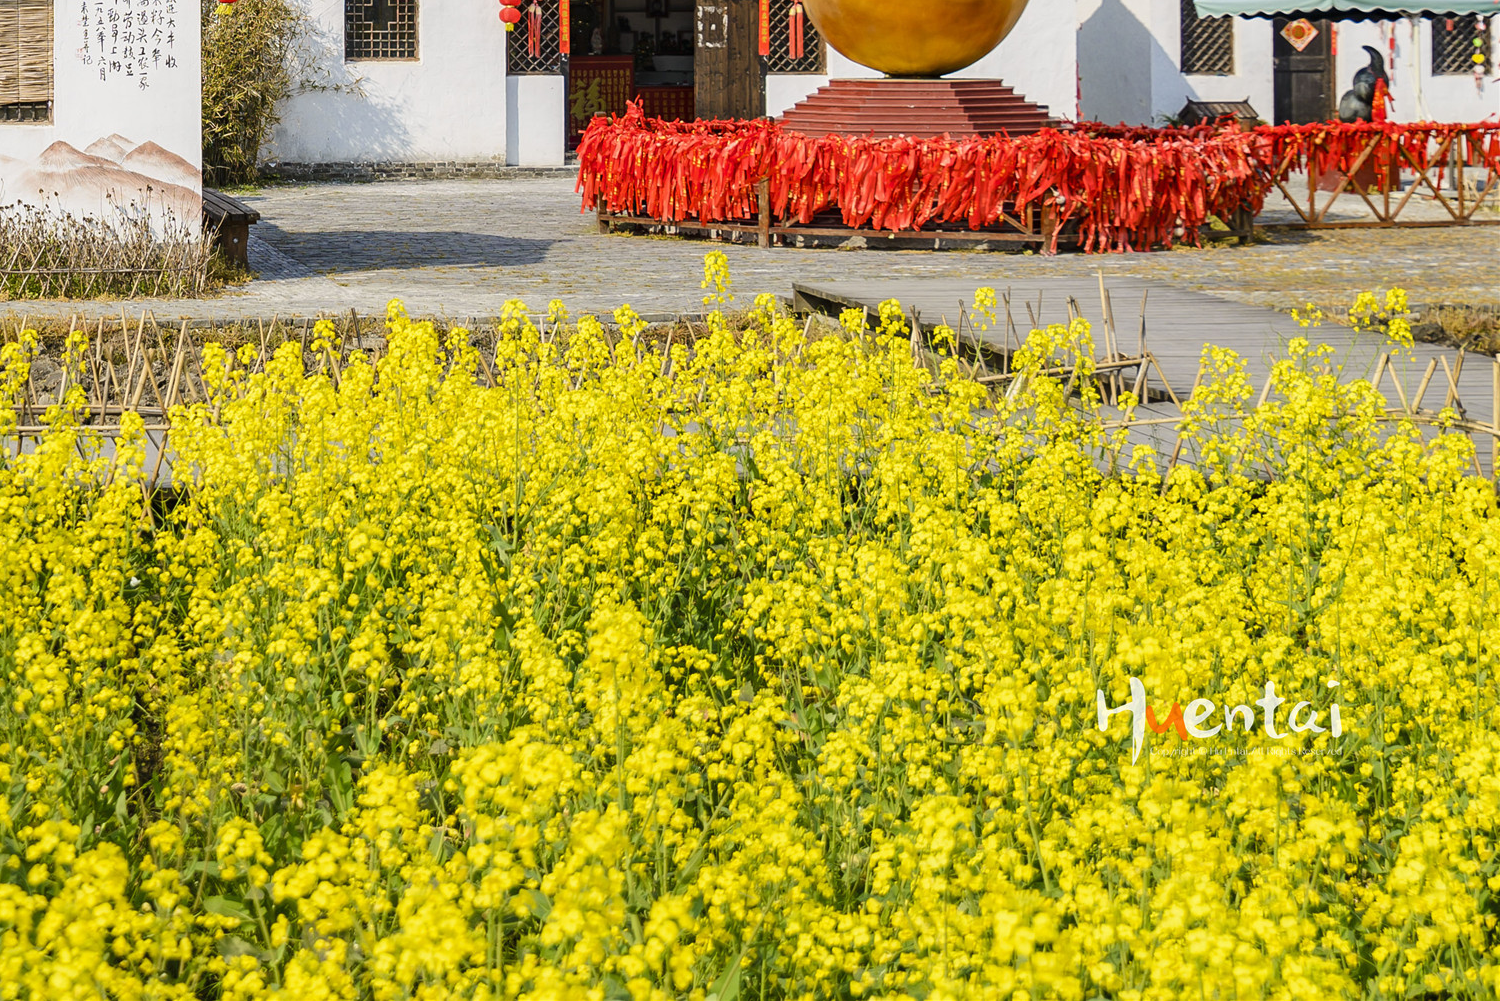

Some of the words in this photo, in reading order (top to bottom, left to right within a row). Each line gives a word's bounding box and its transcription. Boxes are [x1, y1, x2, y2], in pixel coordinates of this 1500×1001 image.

[94, 2, 107, 81] 一九五八年六月
